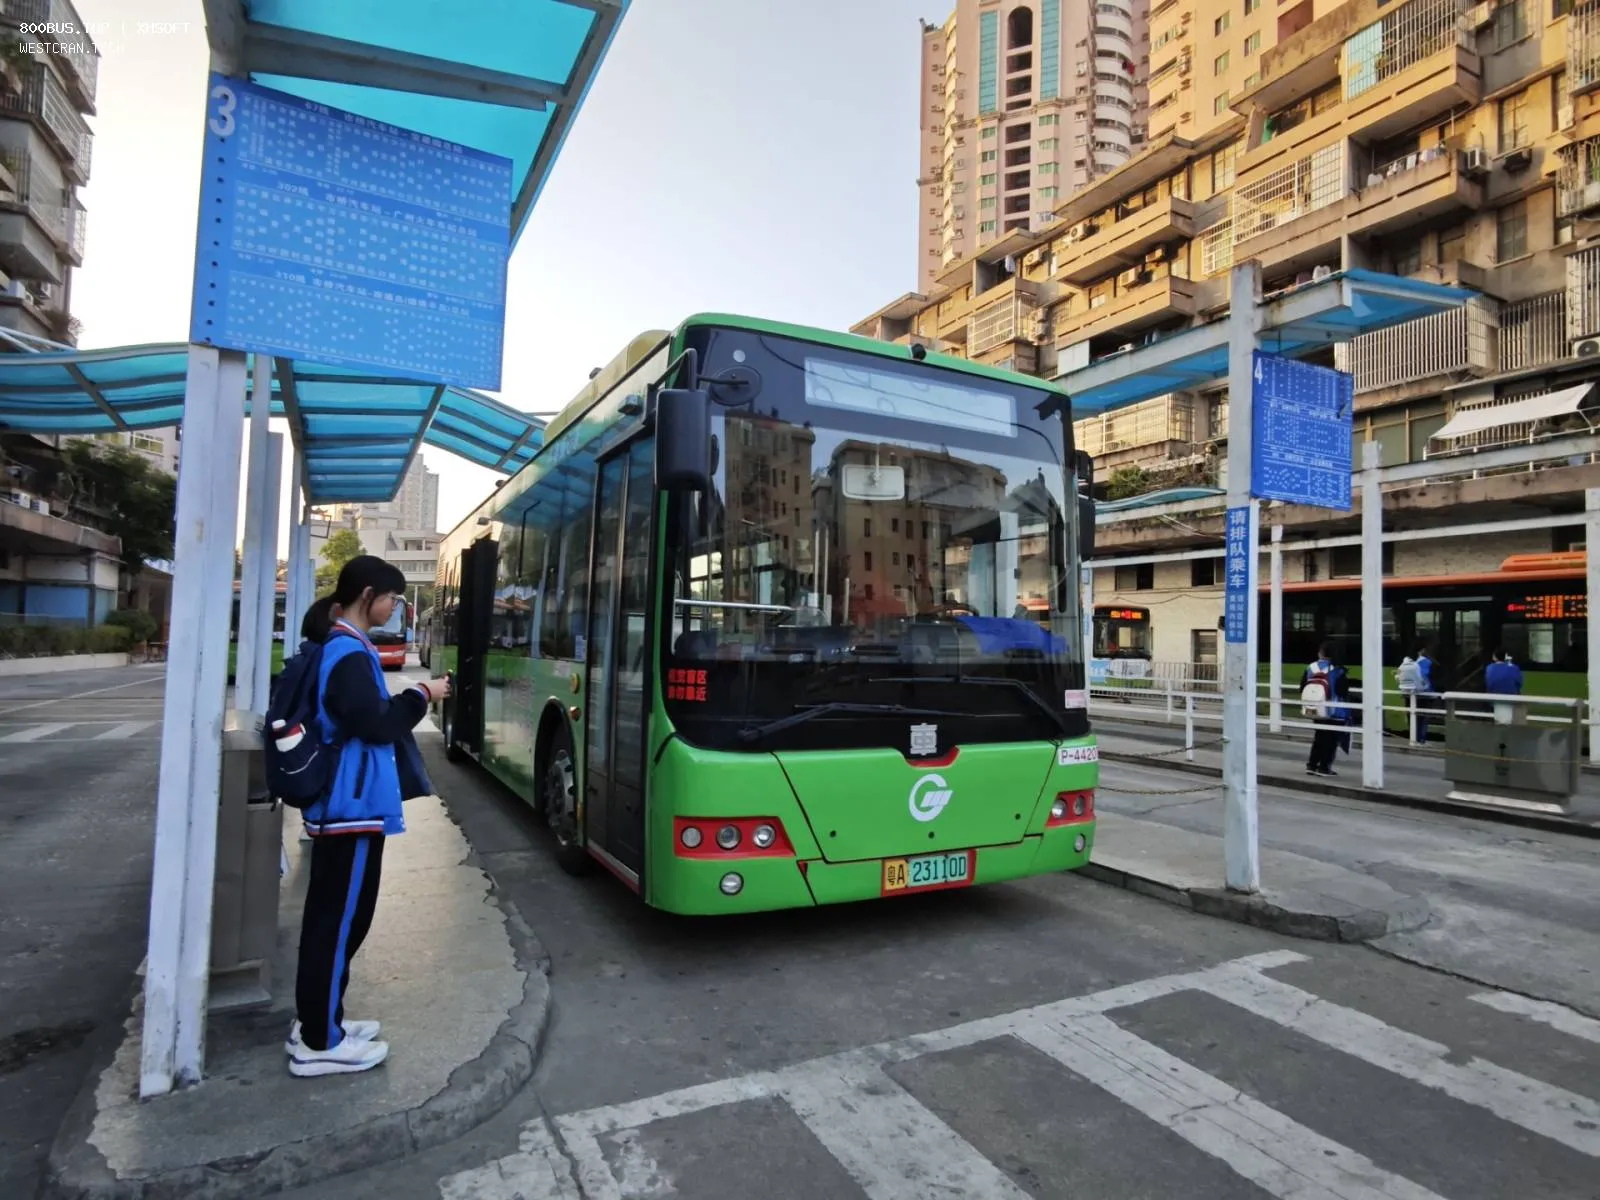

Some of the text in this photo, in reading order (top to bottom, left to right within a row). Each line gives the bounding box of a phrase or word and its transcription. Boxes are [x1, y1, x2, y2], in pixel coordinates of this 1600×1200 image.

[208, 85, 237, 137] 3
[1254, 357, 1263, 385] 4
[1229, 510, 1247, 589] 请排队乘车
